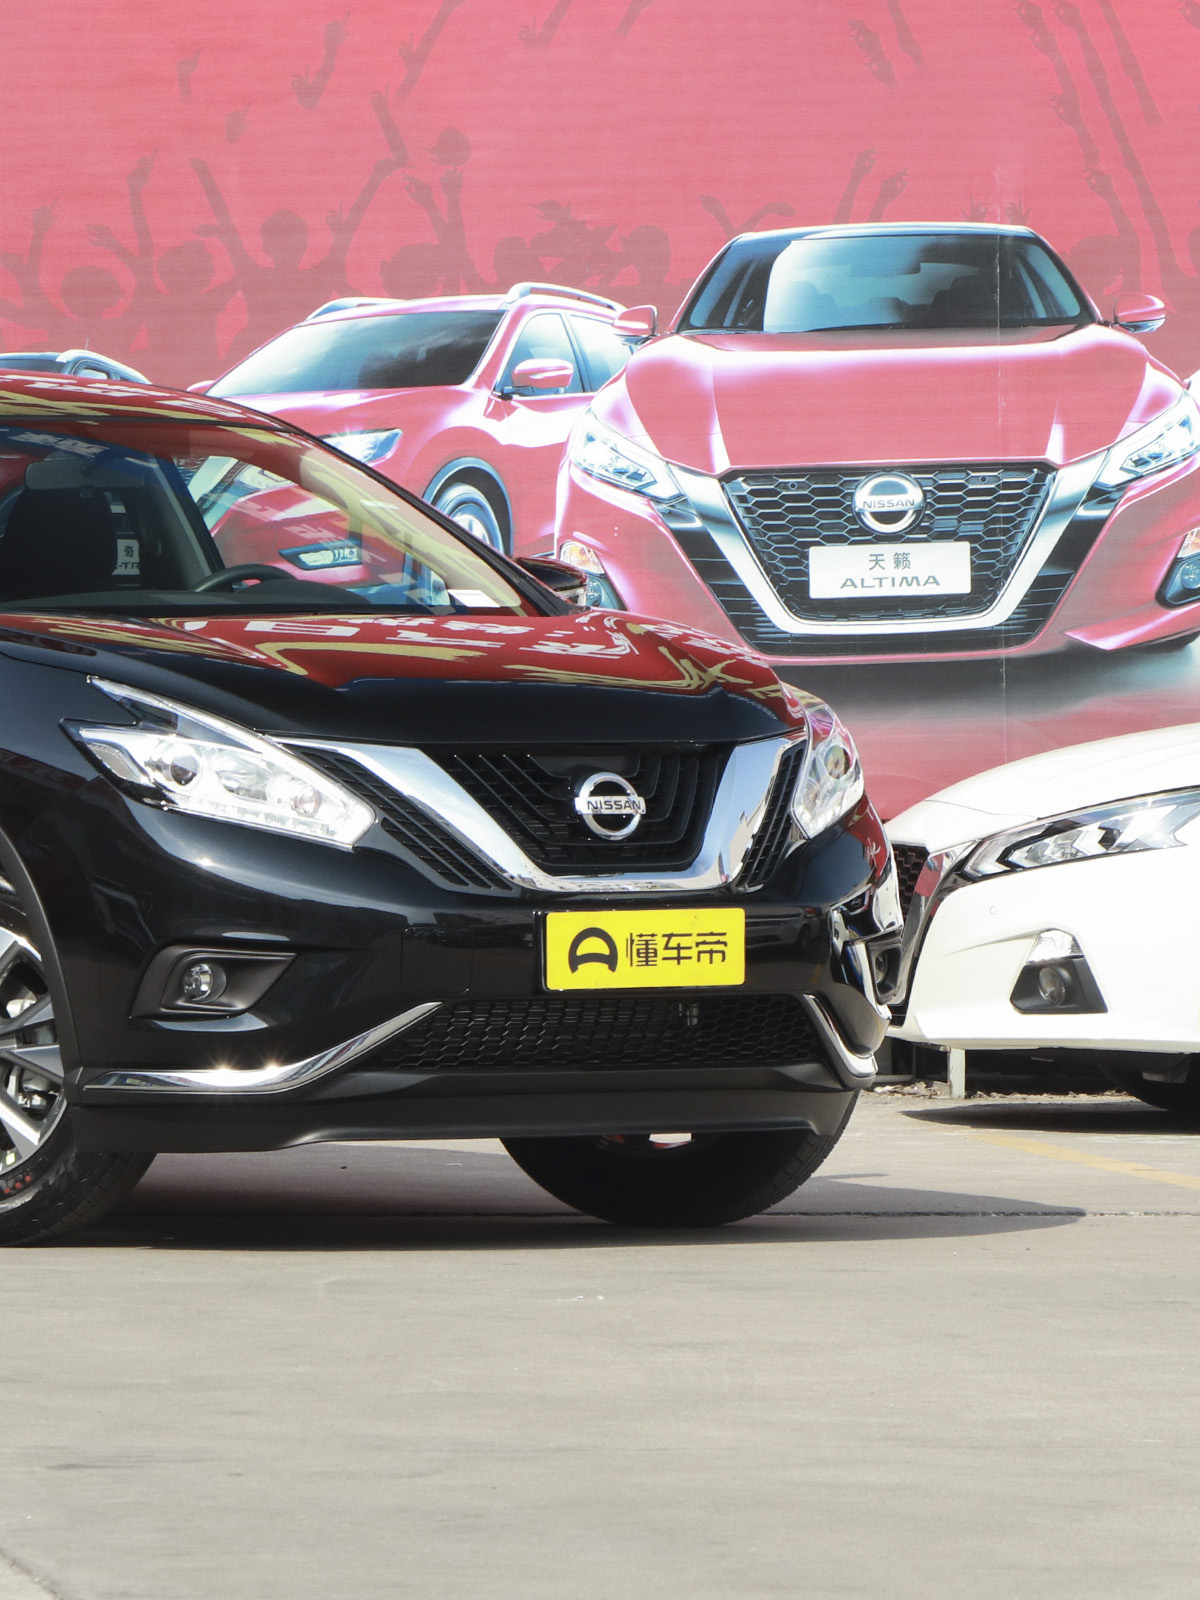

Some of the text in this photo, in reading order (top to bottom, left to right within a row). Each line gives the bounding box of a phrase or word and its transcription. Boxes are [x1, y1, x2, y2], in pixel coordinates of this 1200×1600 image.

[862, 498, 916, 509] NISSAN
[868, 551, 912, 571] 天籁
[839, 575, 941, 590] ALTIMA
[586, 799, 642, 811] NISSAN
[626, 931, 728, 967] 懂车帝
